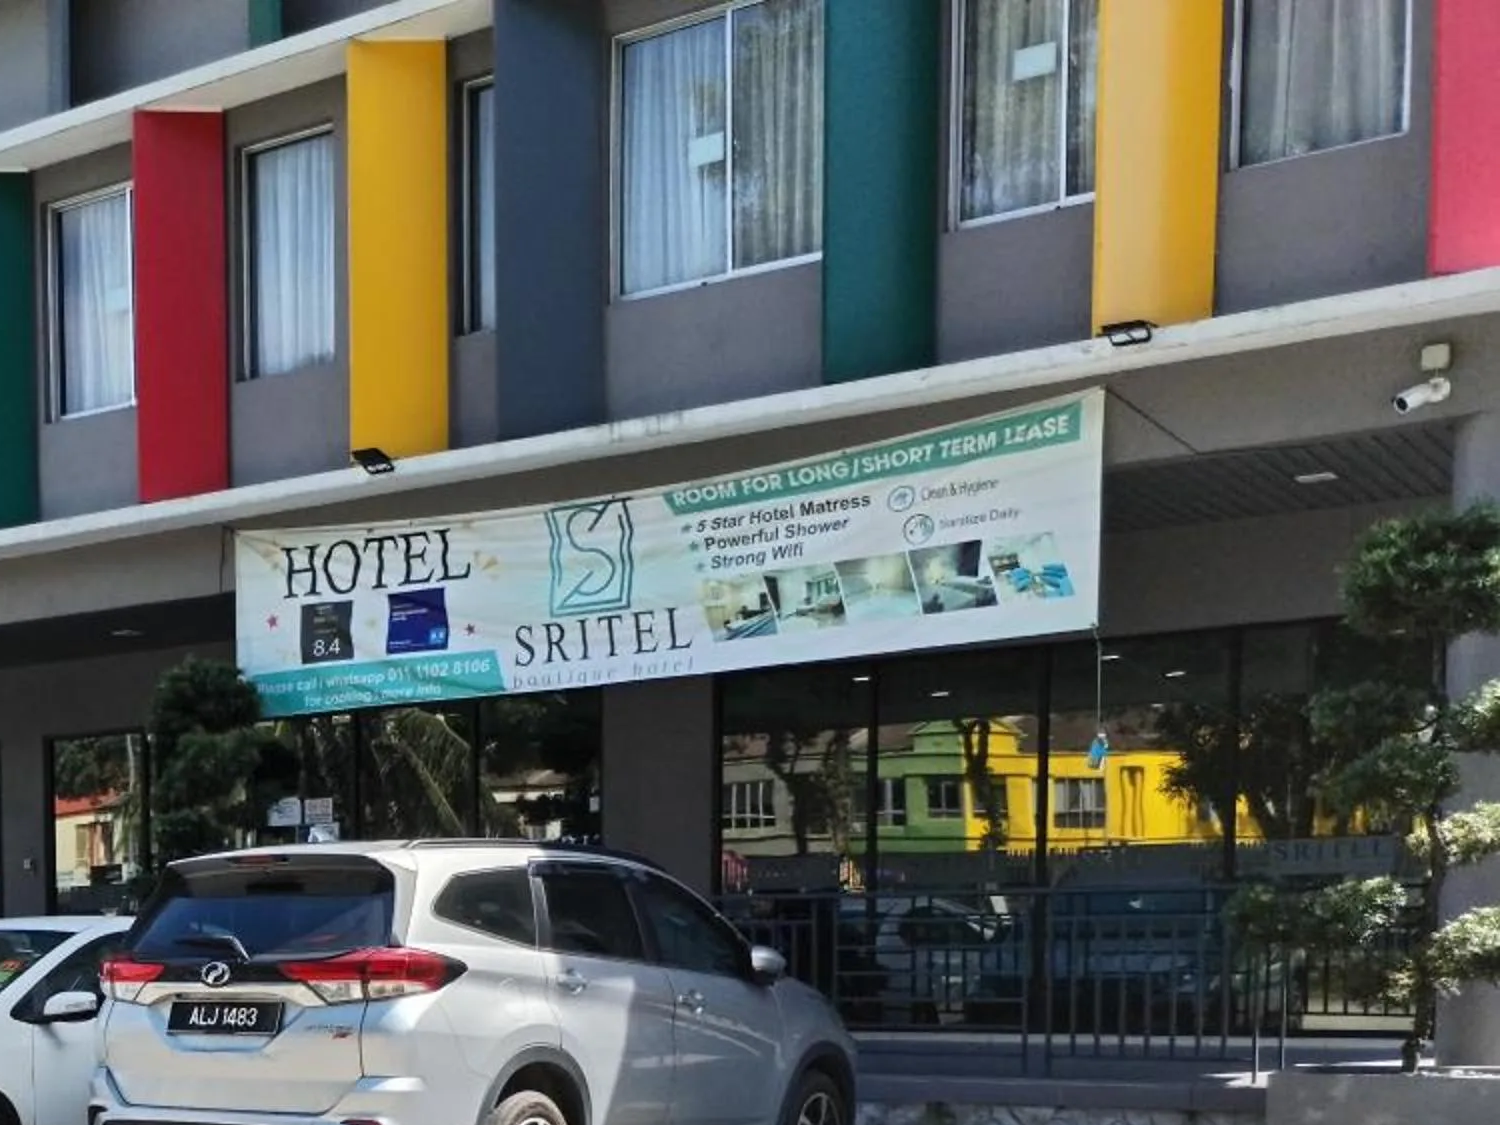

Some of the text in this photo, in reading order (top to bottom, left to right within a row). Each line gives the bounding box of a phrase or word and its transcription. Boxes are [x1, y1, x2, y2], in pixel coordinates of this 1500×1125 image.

[672, 483, 736, 507] ROOM
[742, 474, 784, 496] FOR
[939, 431, 997, 459] TERM
[1004, 413, 1070, 445] LEASE
[697, 494, 871, 533] 5 Star Hotel Matress
[704, 516, 850, 552] Powerful Shower
[281, 528, 471, 599] HOTEL
[711, 550, 766, 571] Strong
[313, 637, 341, 657] 8.4
[515, 607, 693, 668] SRITEL
[633, 656, 693, 678] hotel
[189, 1006, 258, 1026] ALJ 1483
